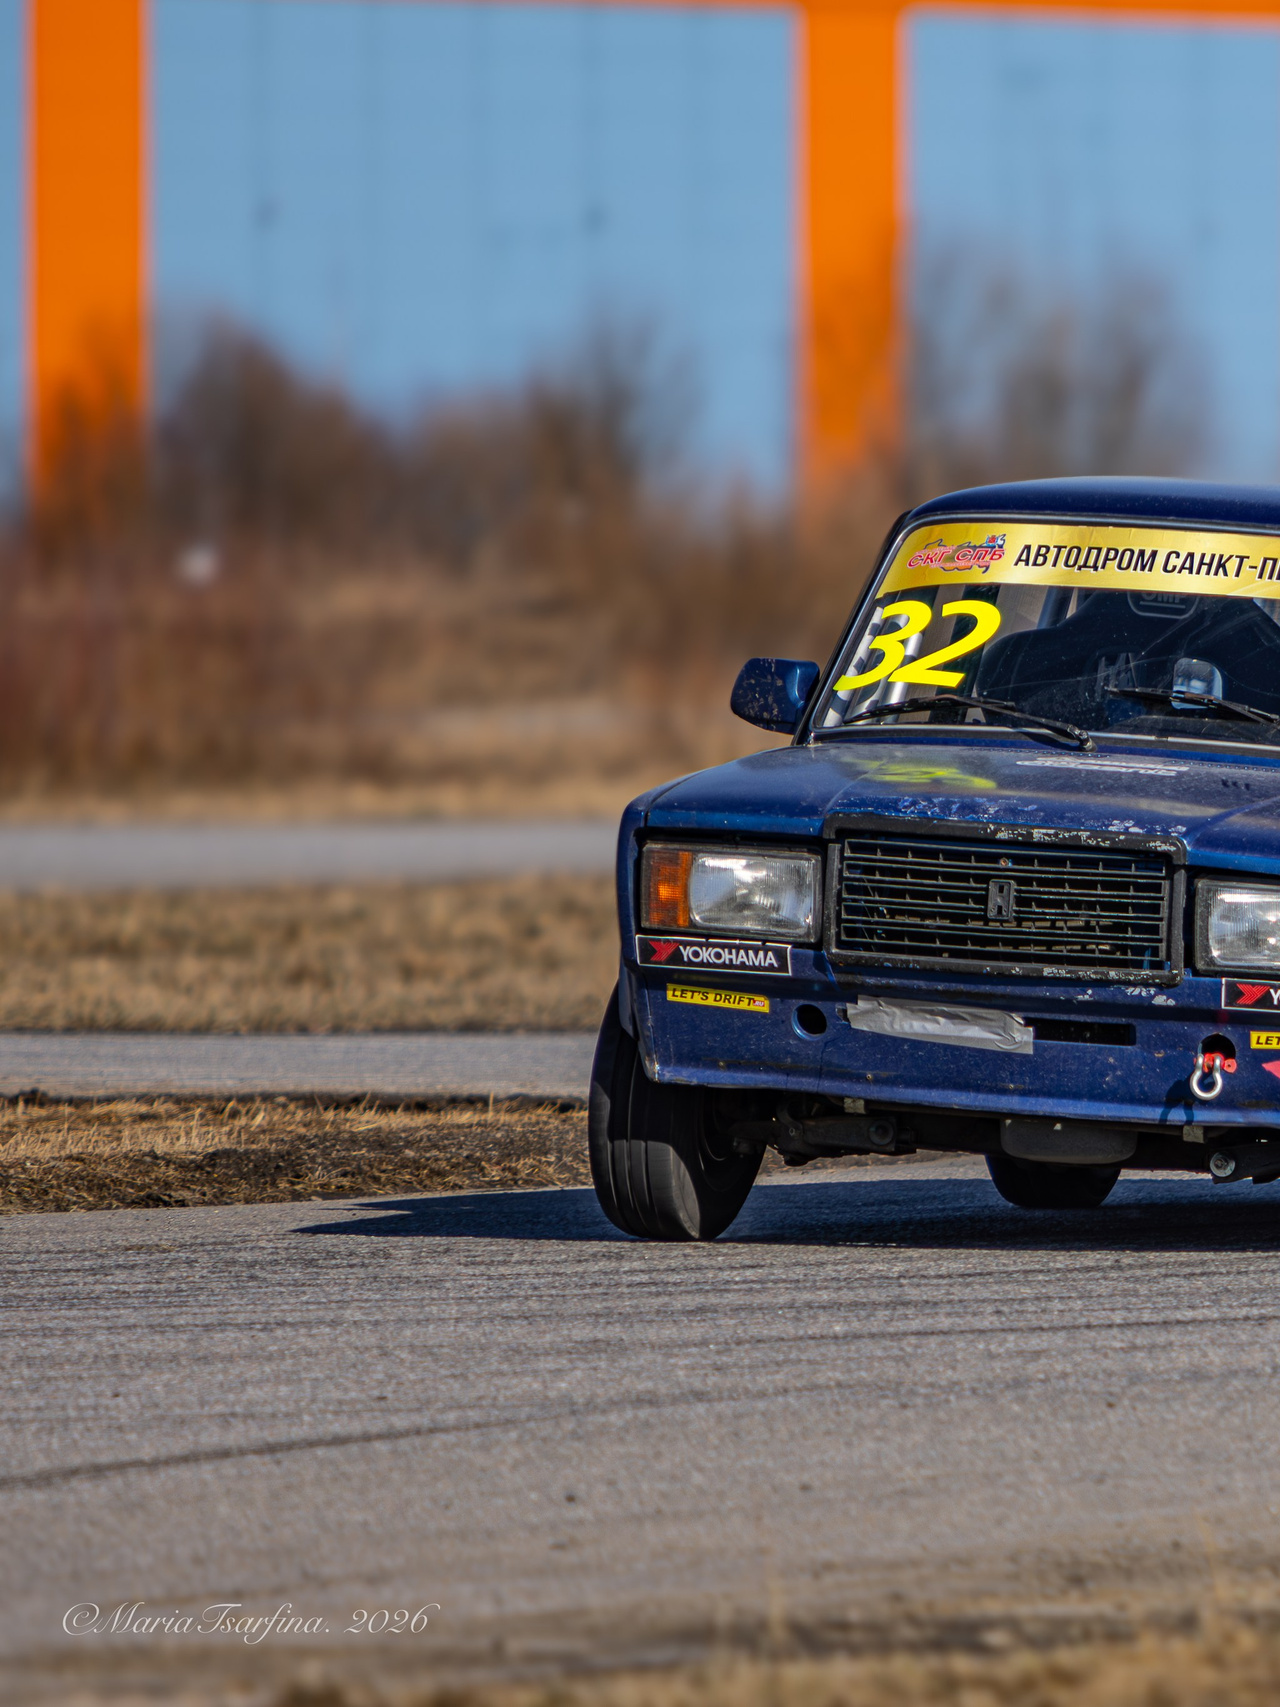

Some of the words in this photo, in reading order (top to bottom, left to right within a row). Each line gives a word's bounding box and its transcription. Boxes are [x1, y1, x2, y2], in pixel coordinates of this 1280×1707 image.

[907, 549, 952, 568] СКГ
[955, 548, 1005, 562] СПБ
[1013, 544, 1158, 572] АВТОДРОМ
[832, 599, 1002, 691] 32
[679, 945, 778, 968] YOKOHAMA
